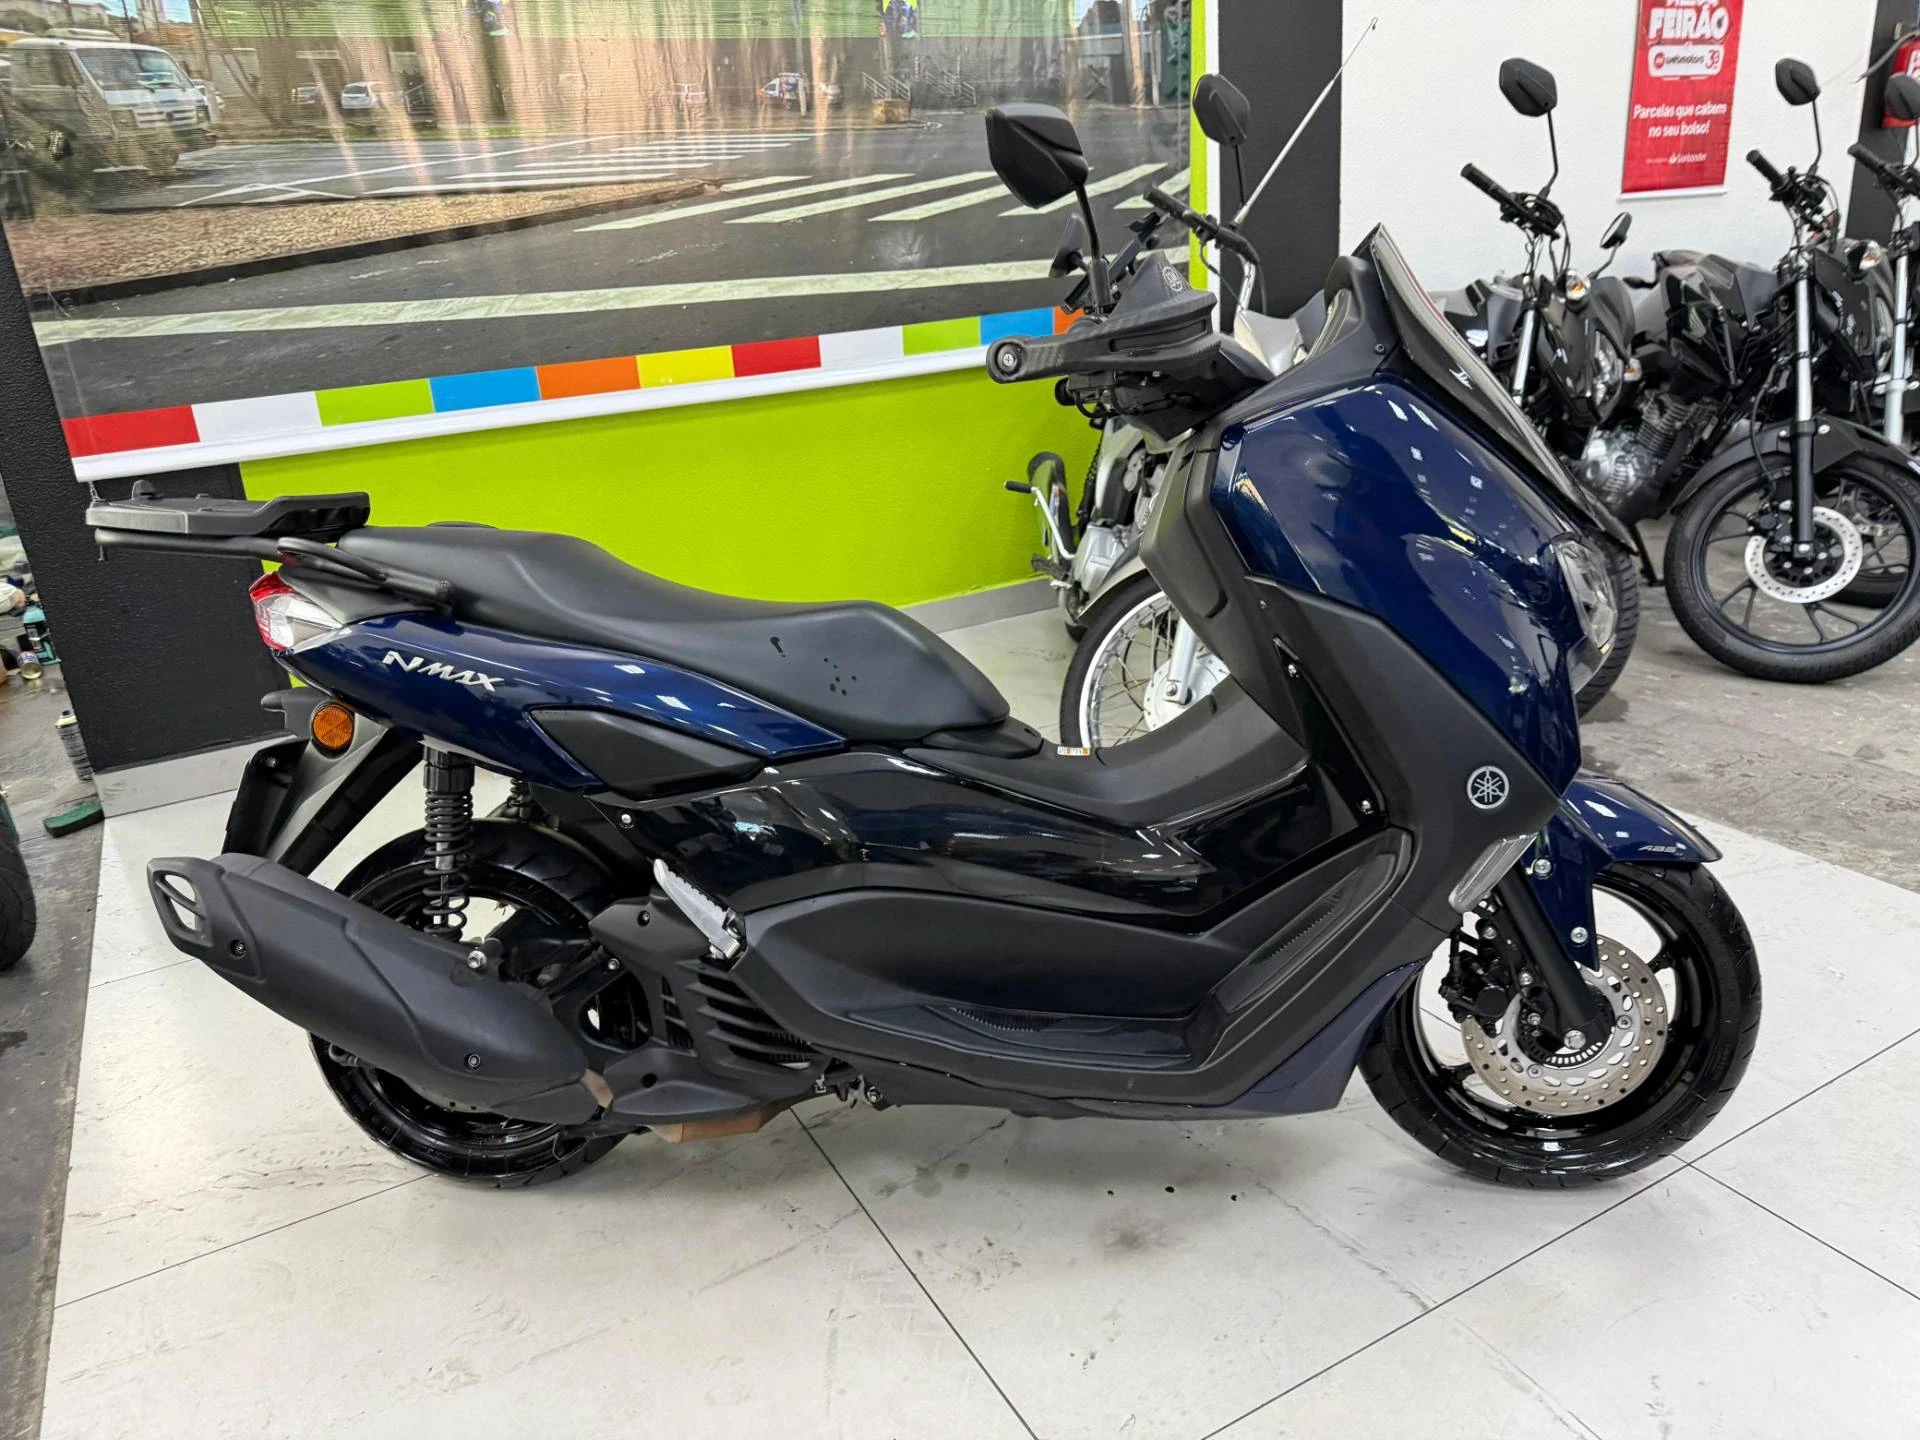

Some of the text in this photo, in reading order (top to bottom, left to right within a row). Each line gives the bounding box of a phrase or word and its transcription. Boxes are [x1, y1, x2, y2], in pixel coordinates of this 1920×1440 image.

[1648, 4, 1729, 40] FEIRÃO
[1633, 102, 1727, 119] Parcelas que cabem
[1648, 120, 1711, 138] no seu bolso!
[382, 650, 505, 692] NMAX
[1638, 845, 1678, 853] ABS
